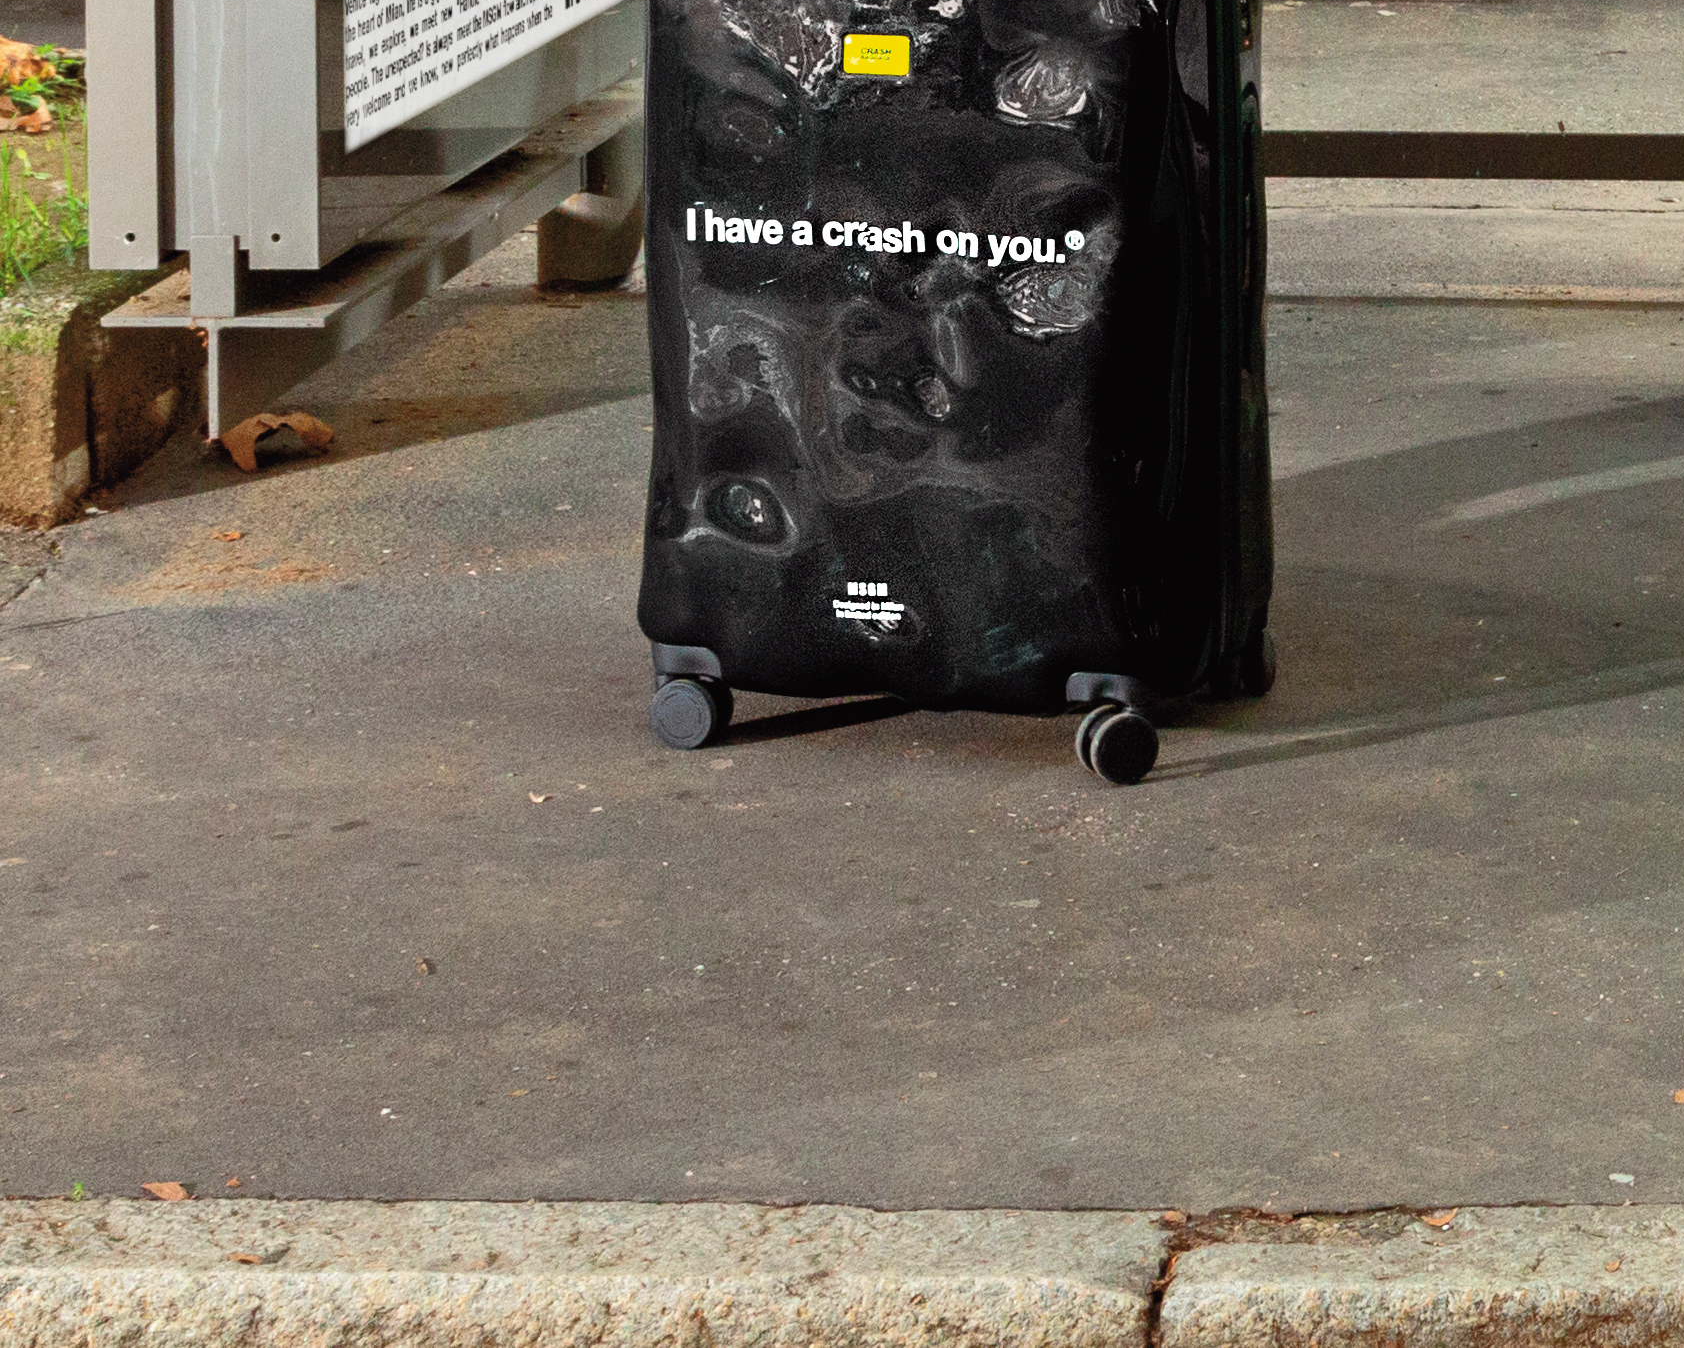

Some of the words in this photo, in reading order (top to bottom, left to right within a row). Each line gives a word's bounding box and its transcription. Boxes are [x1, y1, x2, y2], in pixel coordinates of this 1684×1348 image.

[685, 207, 698, 241] I
[704, 210, 782, 246] have
[791, 220, 813, 246] a
[821, 218, 926, 254] crash
[935, 227, 978, 257] on
